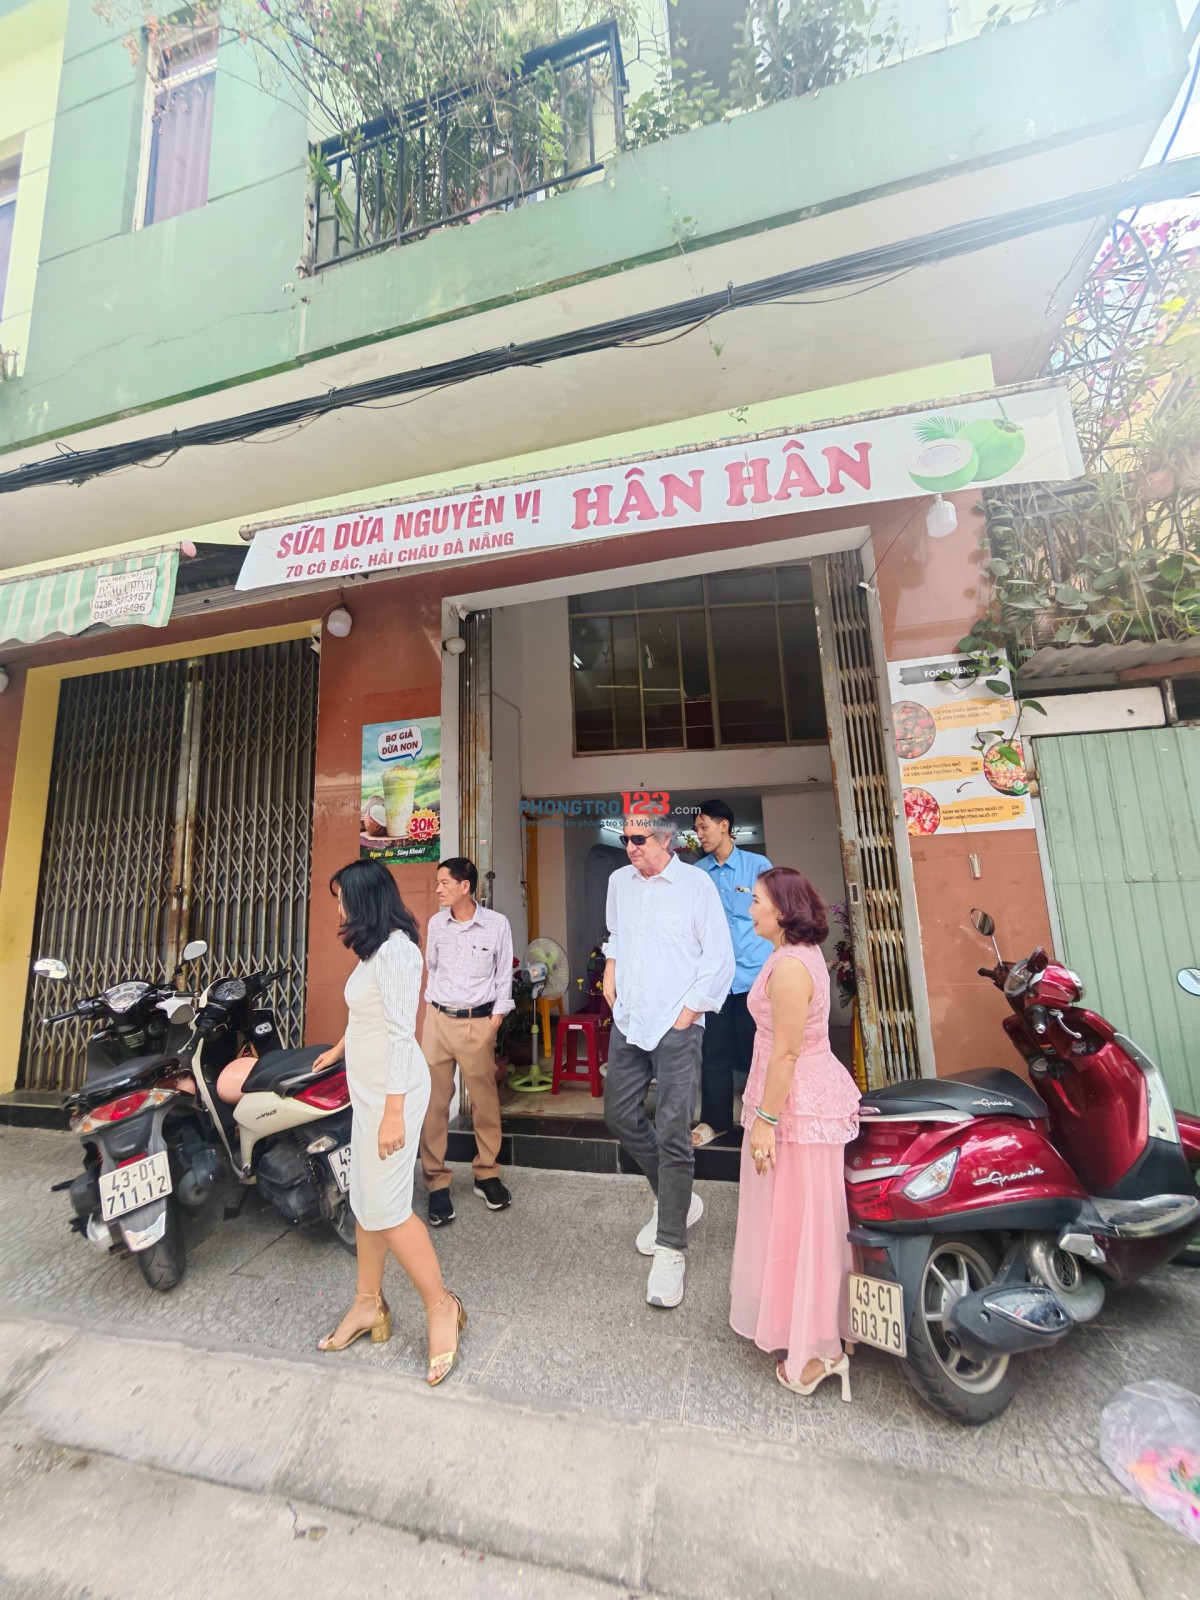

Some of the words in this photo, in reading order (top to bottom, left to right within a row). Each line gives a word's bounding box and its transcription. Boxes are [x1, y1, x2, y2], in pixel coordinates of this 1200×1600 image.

[571, 467, 705, 530] HÂN
[724, 439, 873, 507] HÂN
[276, 524, 326, 559] SỮA
[333, 515, 384, 551] DỪA
[393, 494, 505, 541] NGUYÊN
[515, 489, 541, 524] VỊ
[286, 565, 303, 578] 70
[306, 560, 326, 576] CÔ
[330, 554, 363, 572] BẮC,
[367, 549, 394, 567] HẢI
[397, 544, 439, 563] CHÂU
[443, 538, 464, 556] ĐÀ
[381, 743, 399, 755] DỪA
[400, 740, 419, 752] NON
[385, 732, 397, 743] BƠ
[399, 729, 413, 740] GIÀ
[409, 817, 435, 833] 30K
[102, 1175, 167, 1214] 711.12
[111, 1159, 156, 1192] 43-D1
[856, 1278, 893, 1315] 43-C1
[851, 1306, 901, 1350] 603.79
